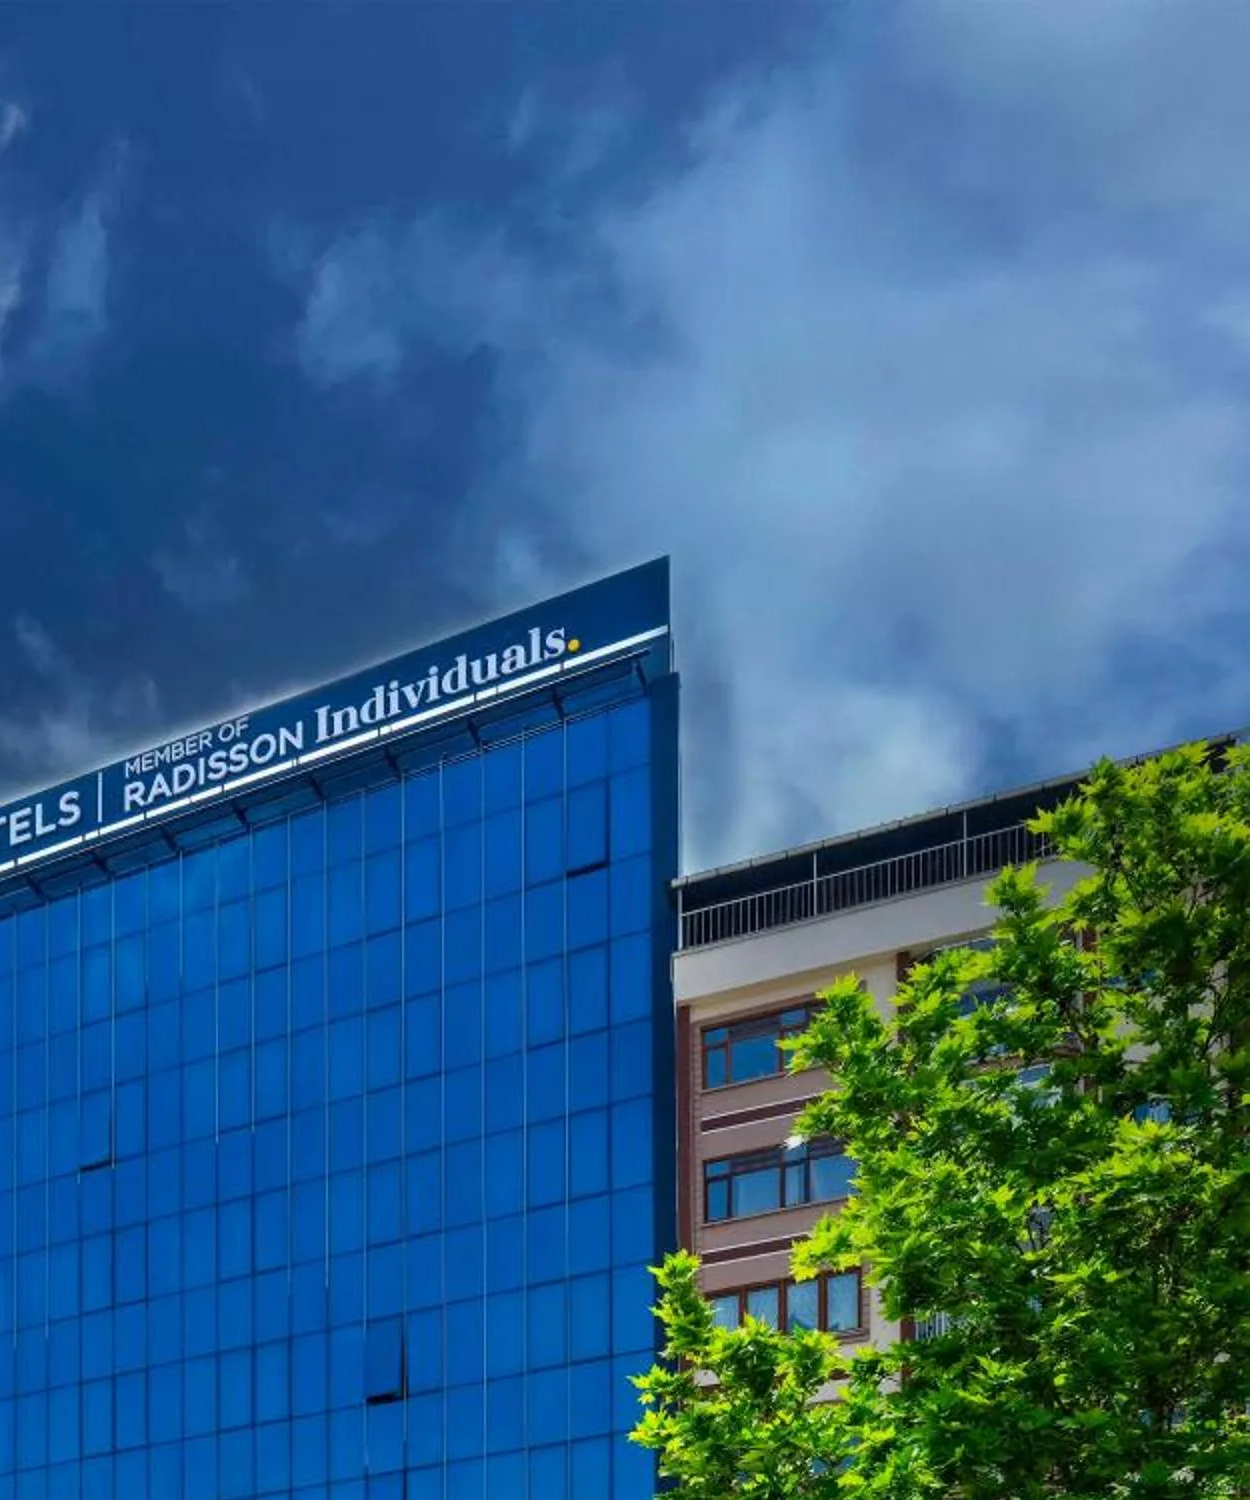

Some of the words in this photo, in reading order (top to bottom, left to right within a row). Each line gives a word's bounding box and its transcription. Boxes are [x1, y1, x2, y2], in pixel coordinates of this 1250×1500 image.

[122, 720, 305, 814] RADISSON
[315, 625, 581, 745] Individuals.
[124, 730, 213, 777] MEMBER
[217, 714, 251, 753] OF
